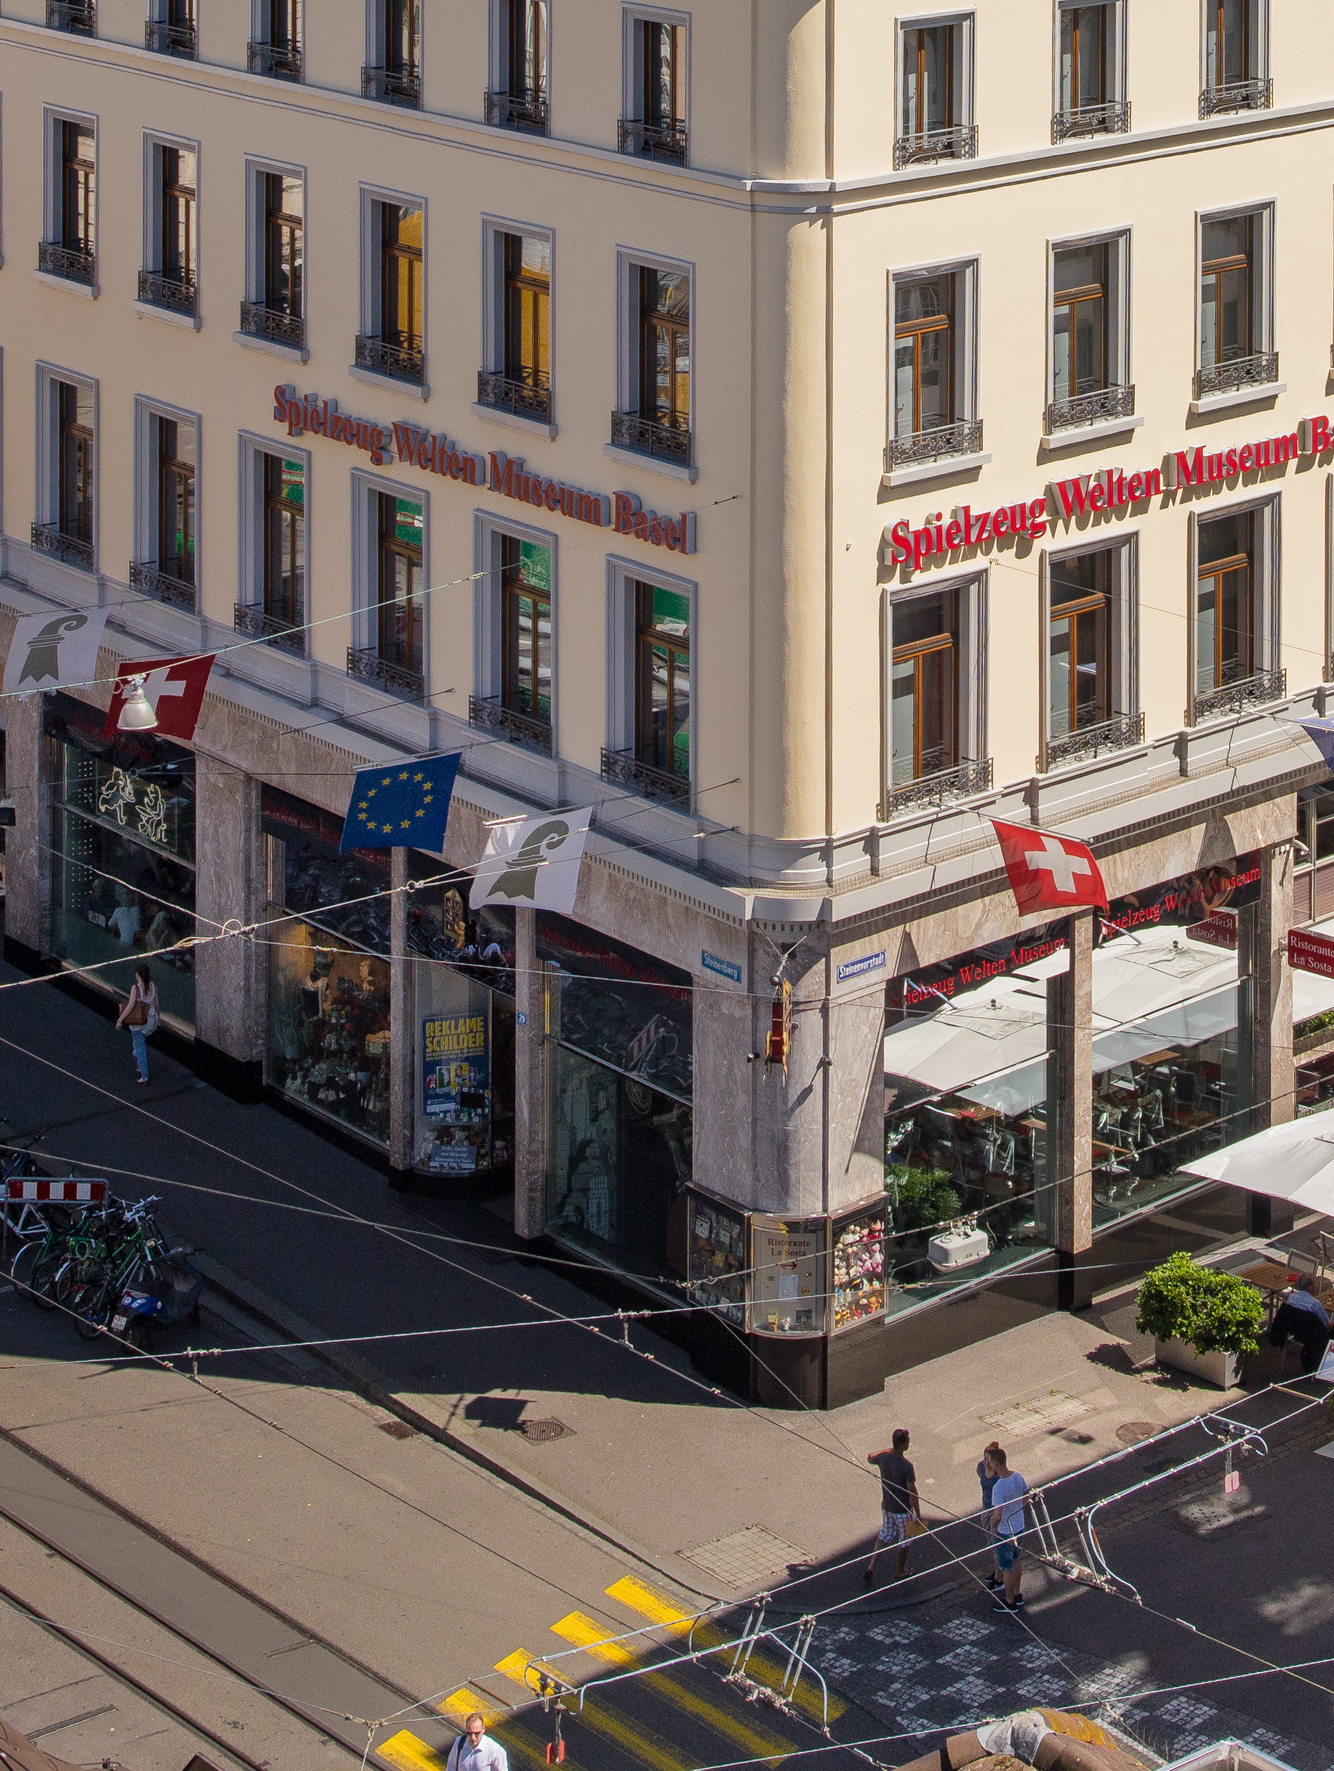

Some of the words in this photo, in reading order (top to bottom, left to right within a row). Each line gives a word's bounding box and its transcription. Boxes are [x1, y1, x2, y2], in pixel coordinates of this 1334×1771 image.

[274, 384, 389, 466] Spielzeug
[392, 421, 483, 486] Welten
[487, 451, 608, 527] Museum
[612, 490, 695, 555] Basel
[886, 497, 1047, 572] Spielzeug
[1051, 467, 1163, 520] Welten
[1169, 431, 1300, 491] Museum
[1101, 903, 1161, 940] Spielzeug
[703, 951, 739, 980] Steinenberg
[838, 951, 886, 979] Steinenvorstadt
[890, 976, 955, 1009] ielzeug
[959, 957, 1007, 986] Welten
[1011, 937, 1066, 968] Museum
[1293, 952, 1306, 965] La
[1307, 956, 1333, 973] Sosta
[425, 1016, 485, 1038] REKLAME
[425, 1032, 485, 1053] SCHILDER
[767, 1237, 811, 1247] Ristorante
[770, 1247, 782, 1256] La
[784, 1248, 807, 1257] Sosta
